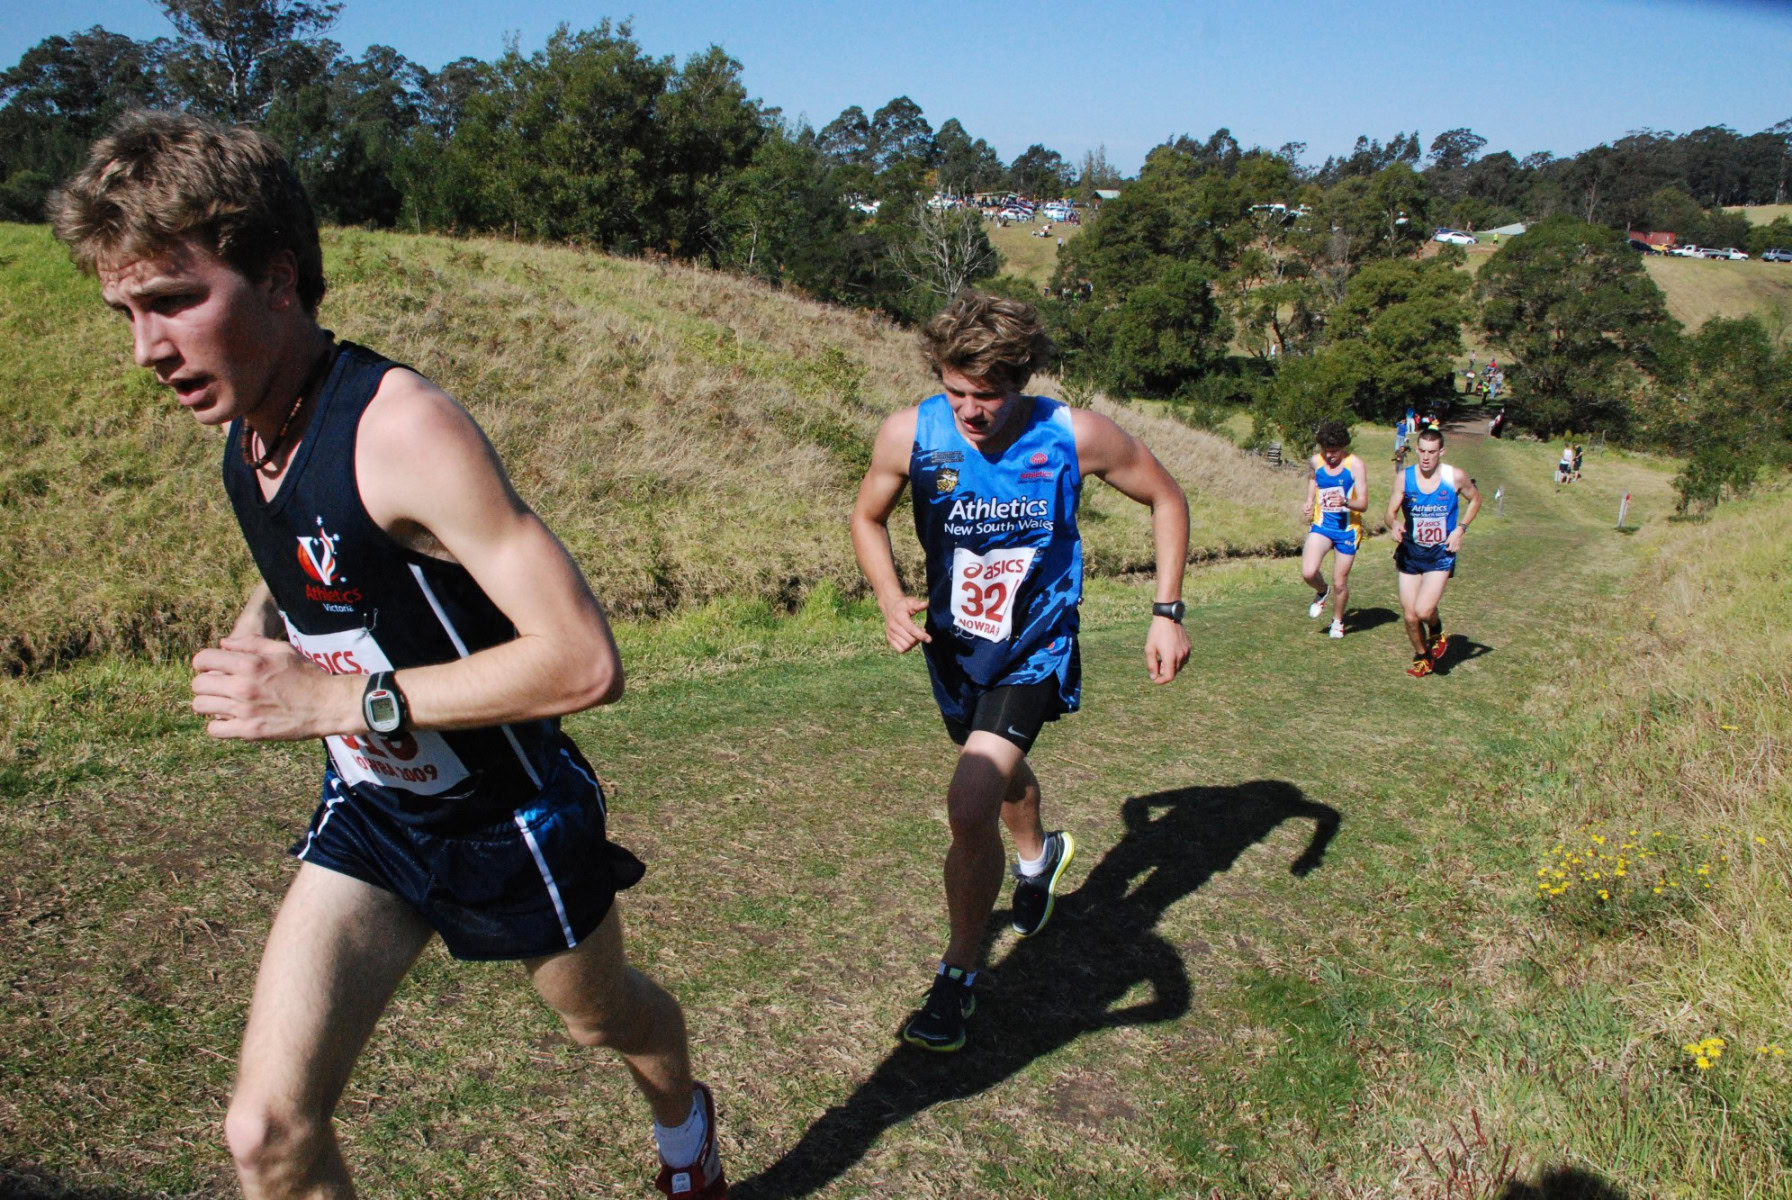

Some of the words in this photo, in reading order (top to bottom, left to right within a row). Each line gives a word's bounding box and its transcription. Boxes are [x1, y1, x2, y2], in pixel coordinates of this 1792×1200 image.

[948, 496, 1048, 520] Athletics
[1411, 504, 1448, 512] Athletics
[944, 523, 973, 536] New
[976, 520, 1015, 535] South
[1018, 519, 1054, 531] Wales
[1417, 527, 1442, 543] 120
[305, 584, 363, 603] Athletics
[961, 581, 1007, 623] 32
[322, 602, 354, 613] Victoria
